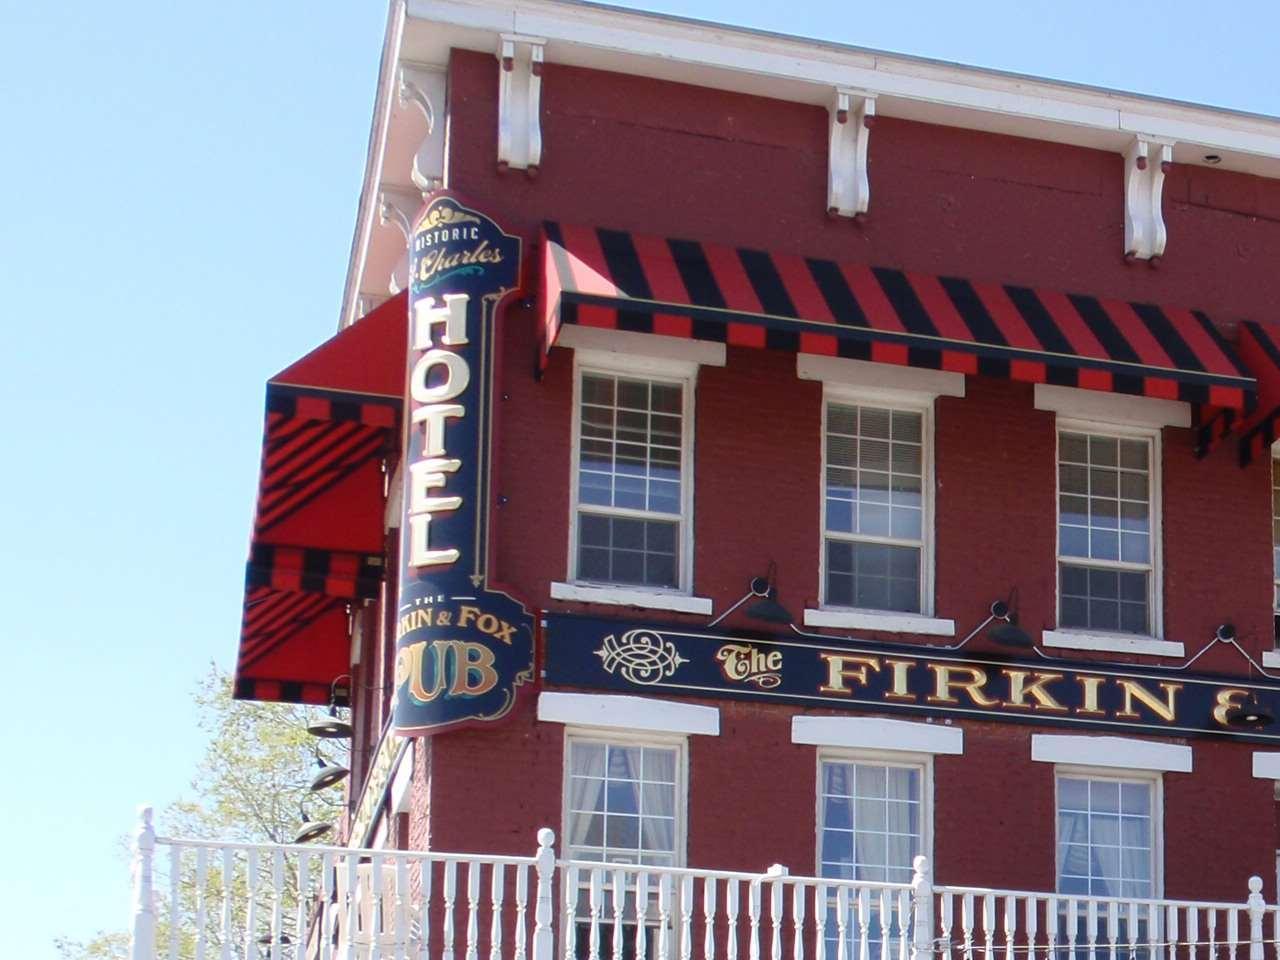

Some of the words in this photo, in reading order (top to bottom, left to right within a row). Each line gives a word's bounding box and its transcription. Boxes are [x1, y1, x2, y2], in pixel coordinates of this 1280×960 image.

[420, 240, 504, 281] Charles
[408, 293, 470, 567] HOTEL
[415, 594, 445, 605] THE
[436, 611, 452, 626] &
[457, 605, 518, 645] FOX
[397, 639, 498, 702] PUB
[715, 643, 784, 688] The
[819, 652, 1184, 722] FIRKIN
